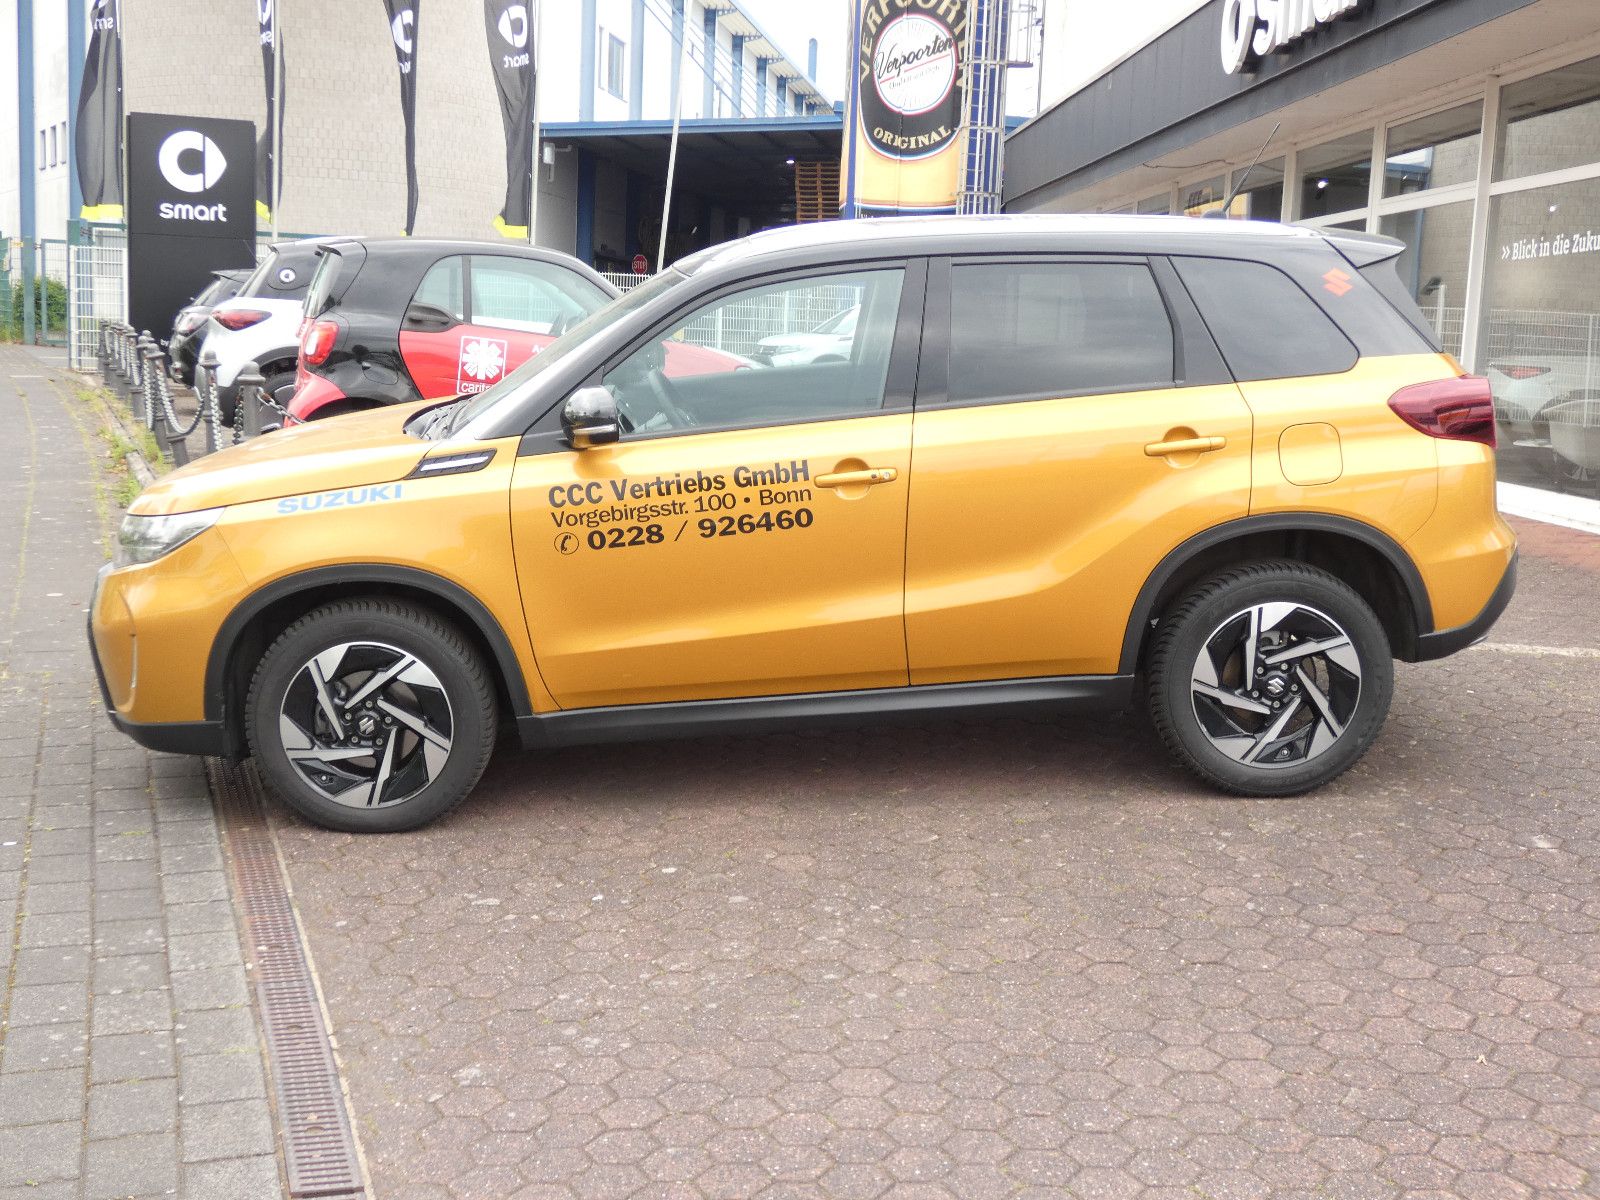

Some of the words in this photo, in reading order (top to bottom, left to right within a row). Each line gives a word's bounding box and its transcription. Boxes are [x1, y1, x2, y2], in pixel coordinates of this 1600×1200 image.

[873, 34, 954, 80] Verpoorten
[873, 125, 952, 149] ORIGINAL
[159, 202, 228, 222] smart
[1512, 238, 1537, 260] Blick
[1539, 236, 1550, 257] in
[1552, 234, 1570, 256] die
[634, 260, 646, 270] STOP
[548, 481, 604, 508] CCC
[609, 470, 726, 502] Vertriebs
[733, 459, 811, 489] GmbH
[277, 484, 402, 514] SUZUKI
[550, 499, 689, 529] Vorgebirgsstr.
[694, 493, 737, 513] 100
[759, 488, 812, 507] Bonn
[586, 524, 665, 551] 0228
[697, 507, 814, 539] 926460
